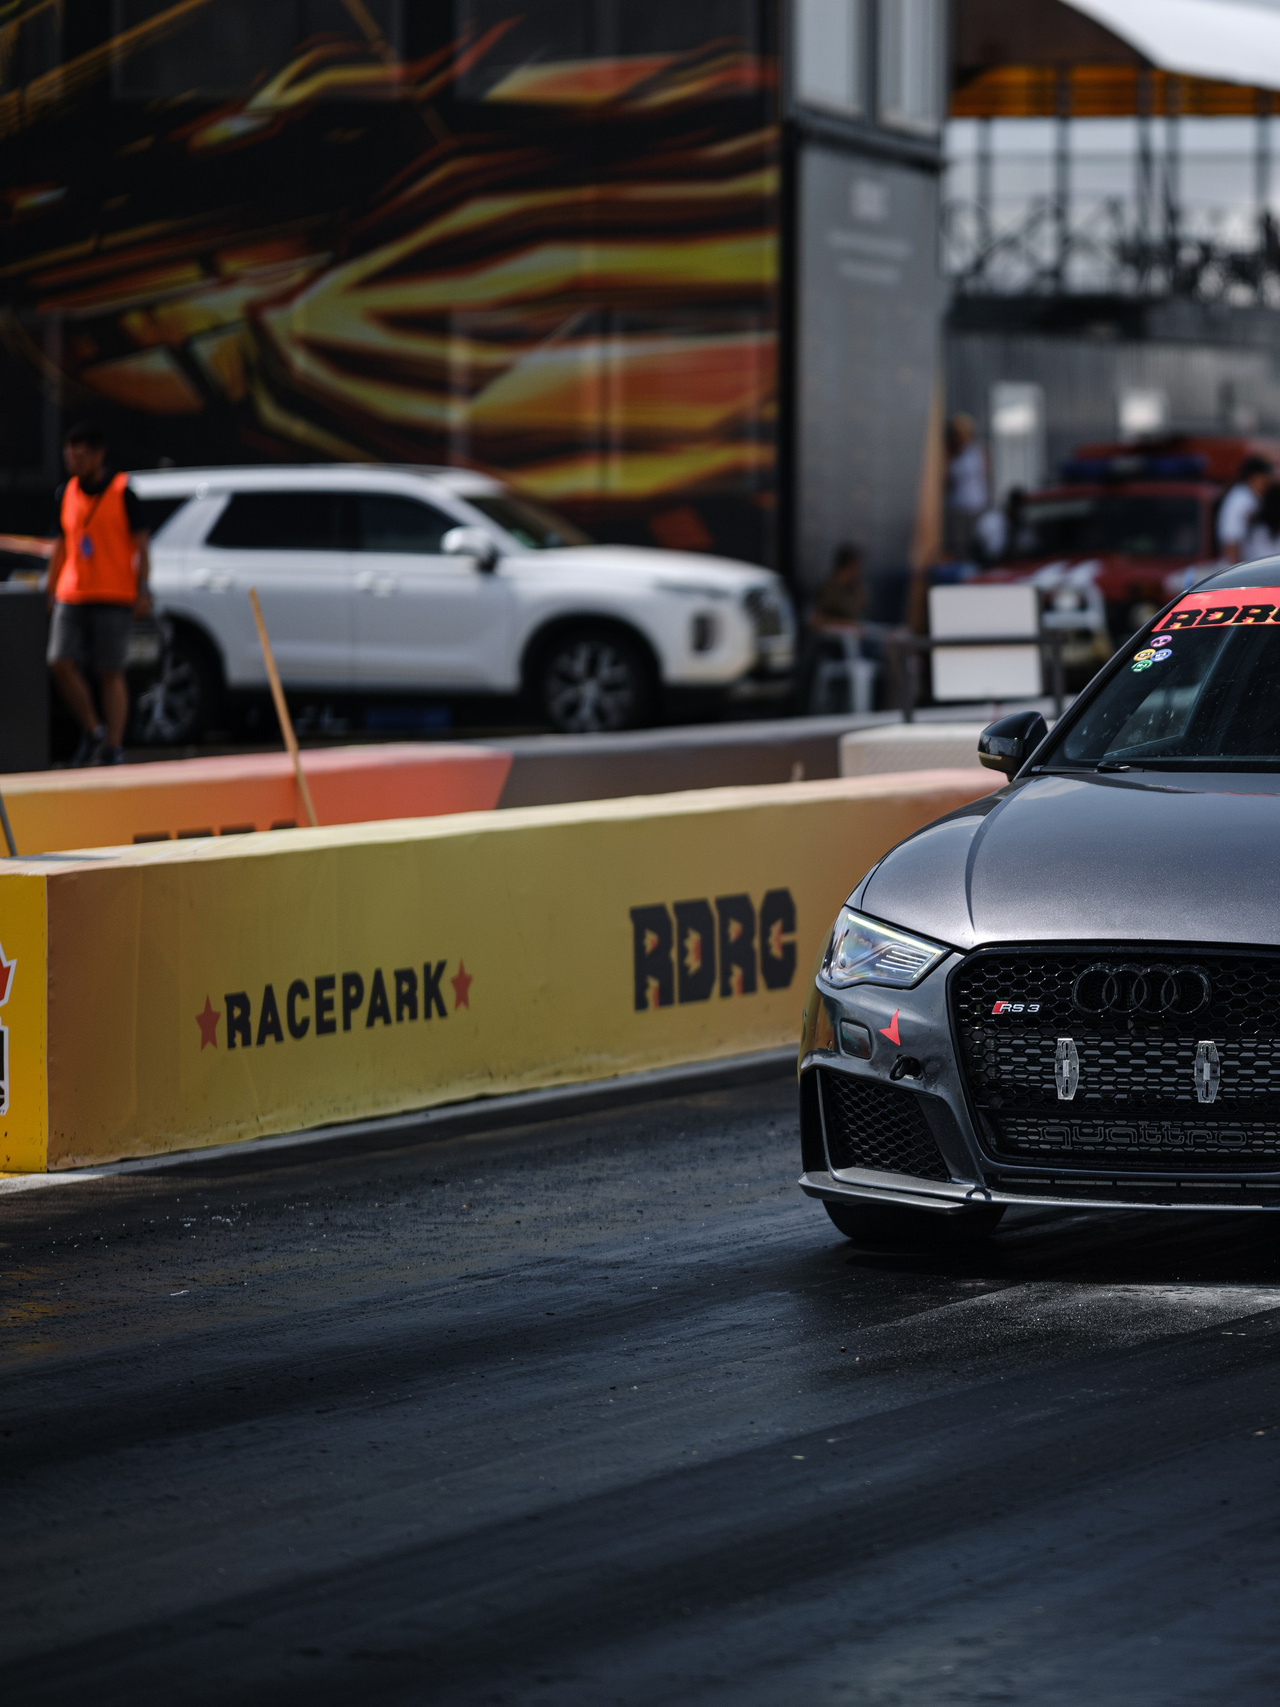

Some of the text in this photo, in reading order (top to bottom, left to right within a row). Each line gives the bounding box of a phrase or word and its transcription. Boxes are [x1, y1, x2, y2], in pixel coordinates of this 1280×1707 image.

[629, 888, 798, 1012] RDRC
[225, 959, 448, 1050] RACEPARK
[1000, 1003, 1040, 1013] RS 3
[1039, 1123, 1249, 1149] quattro
